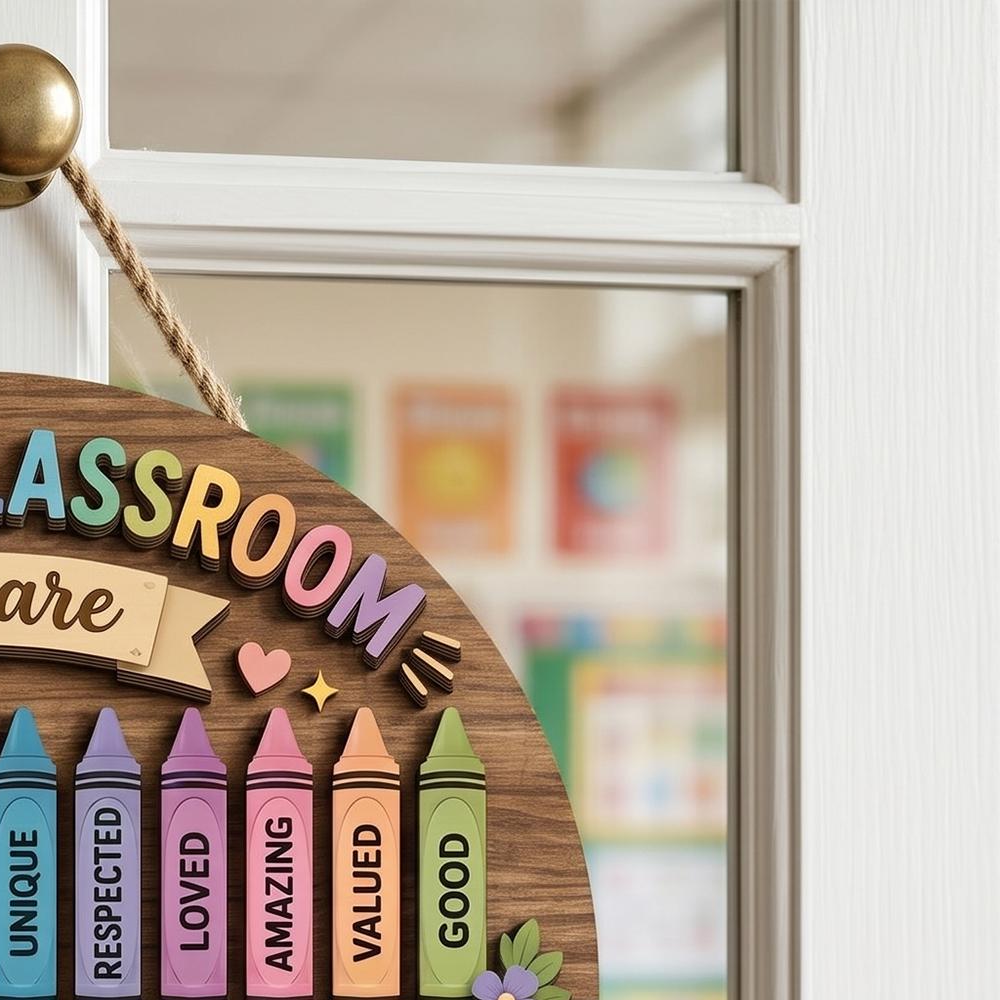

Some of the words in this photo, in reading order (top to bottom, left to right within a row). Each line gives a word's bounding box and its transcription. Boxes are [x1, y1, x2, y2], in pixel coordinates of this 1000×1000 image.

[9, 828, 38, 957] UNIQUE
[93, 806, 122, 980] RESPECTED
[179, 830, 210, 952] LOVED
[264, 815, 293, 973] AMAZING
[351, 822, 382, 963] VALUED
[438, 832, 470, 949] GOOD
